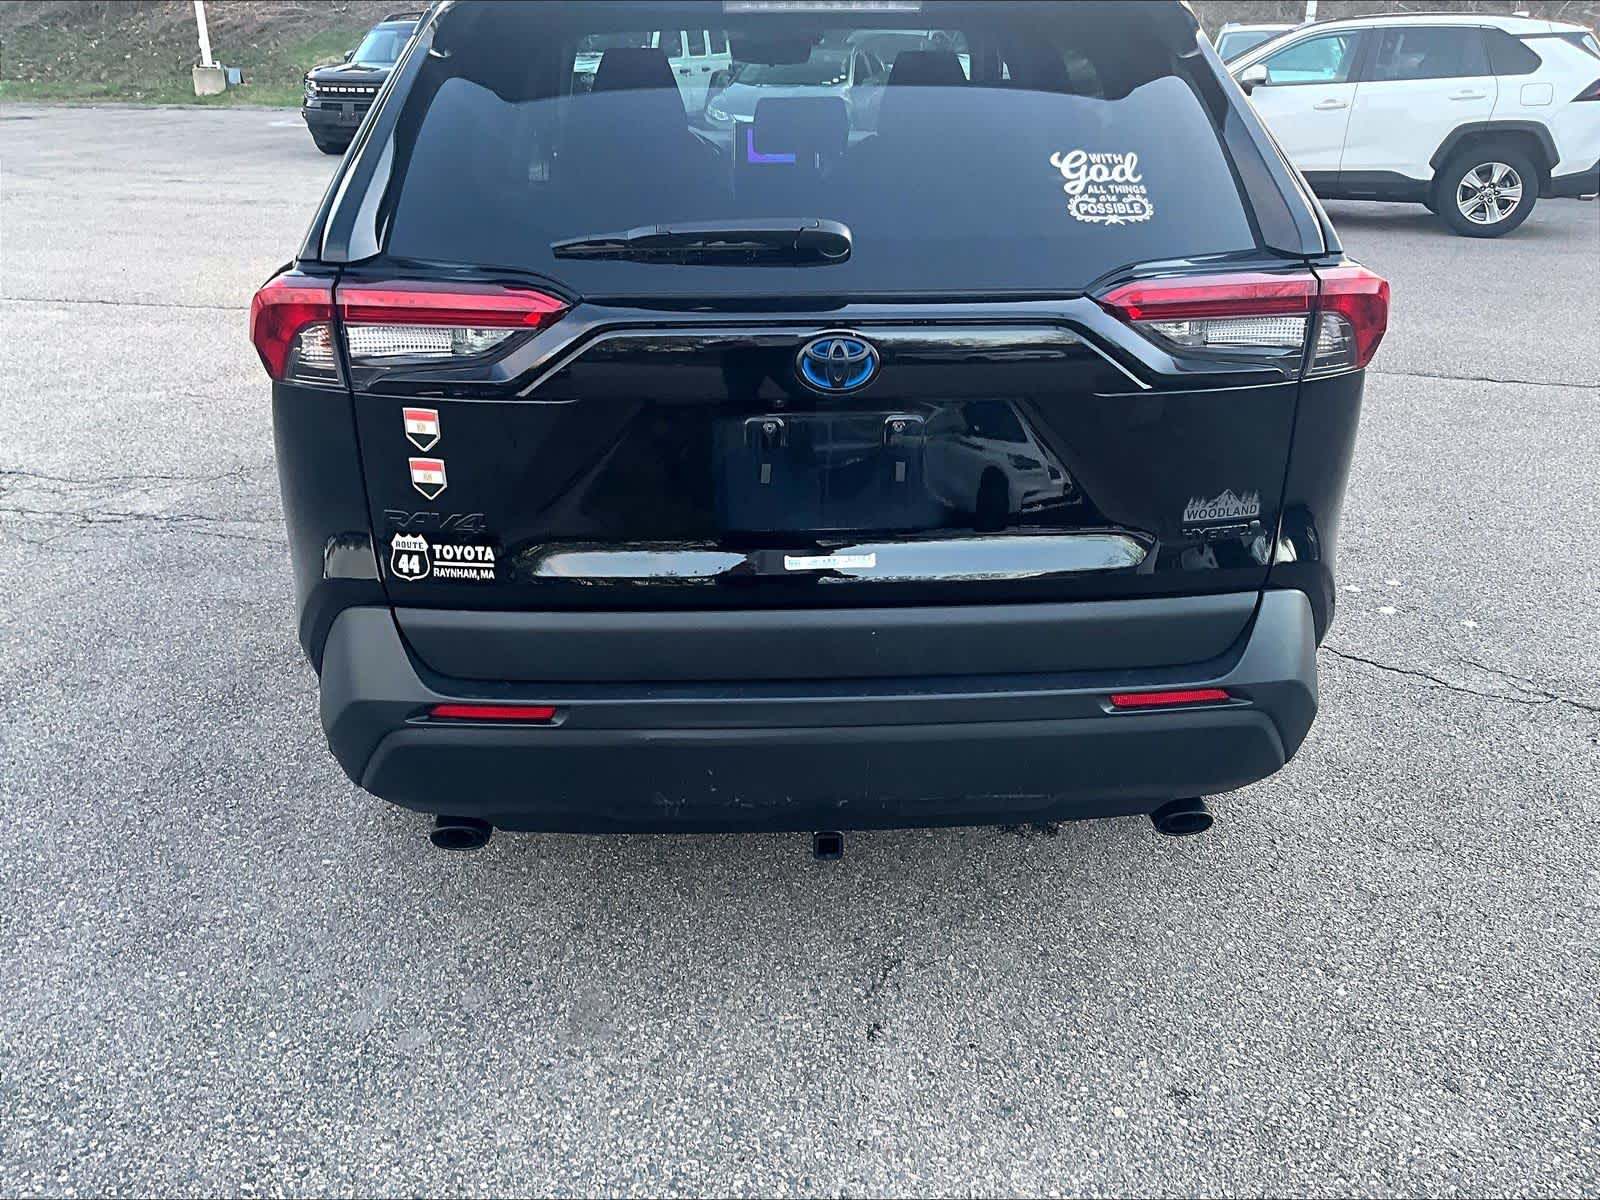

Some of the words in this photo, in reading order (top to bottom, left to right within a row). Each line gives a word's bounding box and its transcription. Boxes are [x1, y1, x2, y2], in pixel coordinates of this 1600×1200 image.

[1088, 153, 1123, 164] WITH
[1050, 150, 1143, 195] God
[1087, 185, 1107, 194] ALL
[1109, 185, 1147, 194] THINGS
[1078, 203, 1143, 214] POSSIBLE
[1186, 504, 1257, 520] WOODLAND
[384, 508, 486, 534] RAV4
[395, 540, 424, 550] ROUTE
[432, 544, 496, 561] TOYOTA
[398, 553, 421, 574] 44
